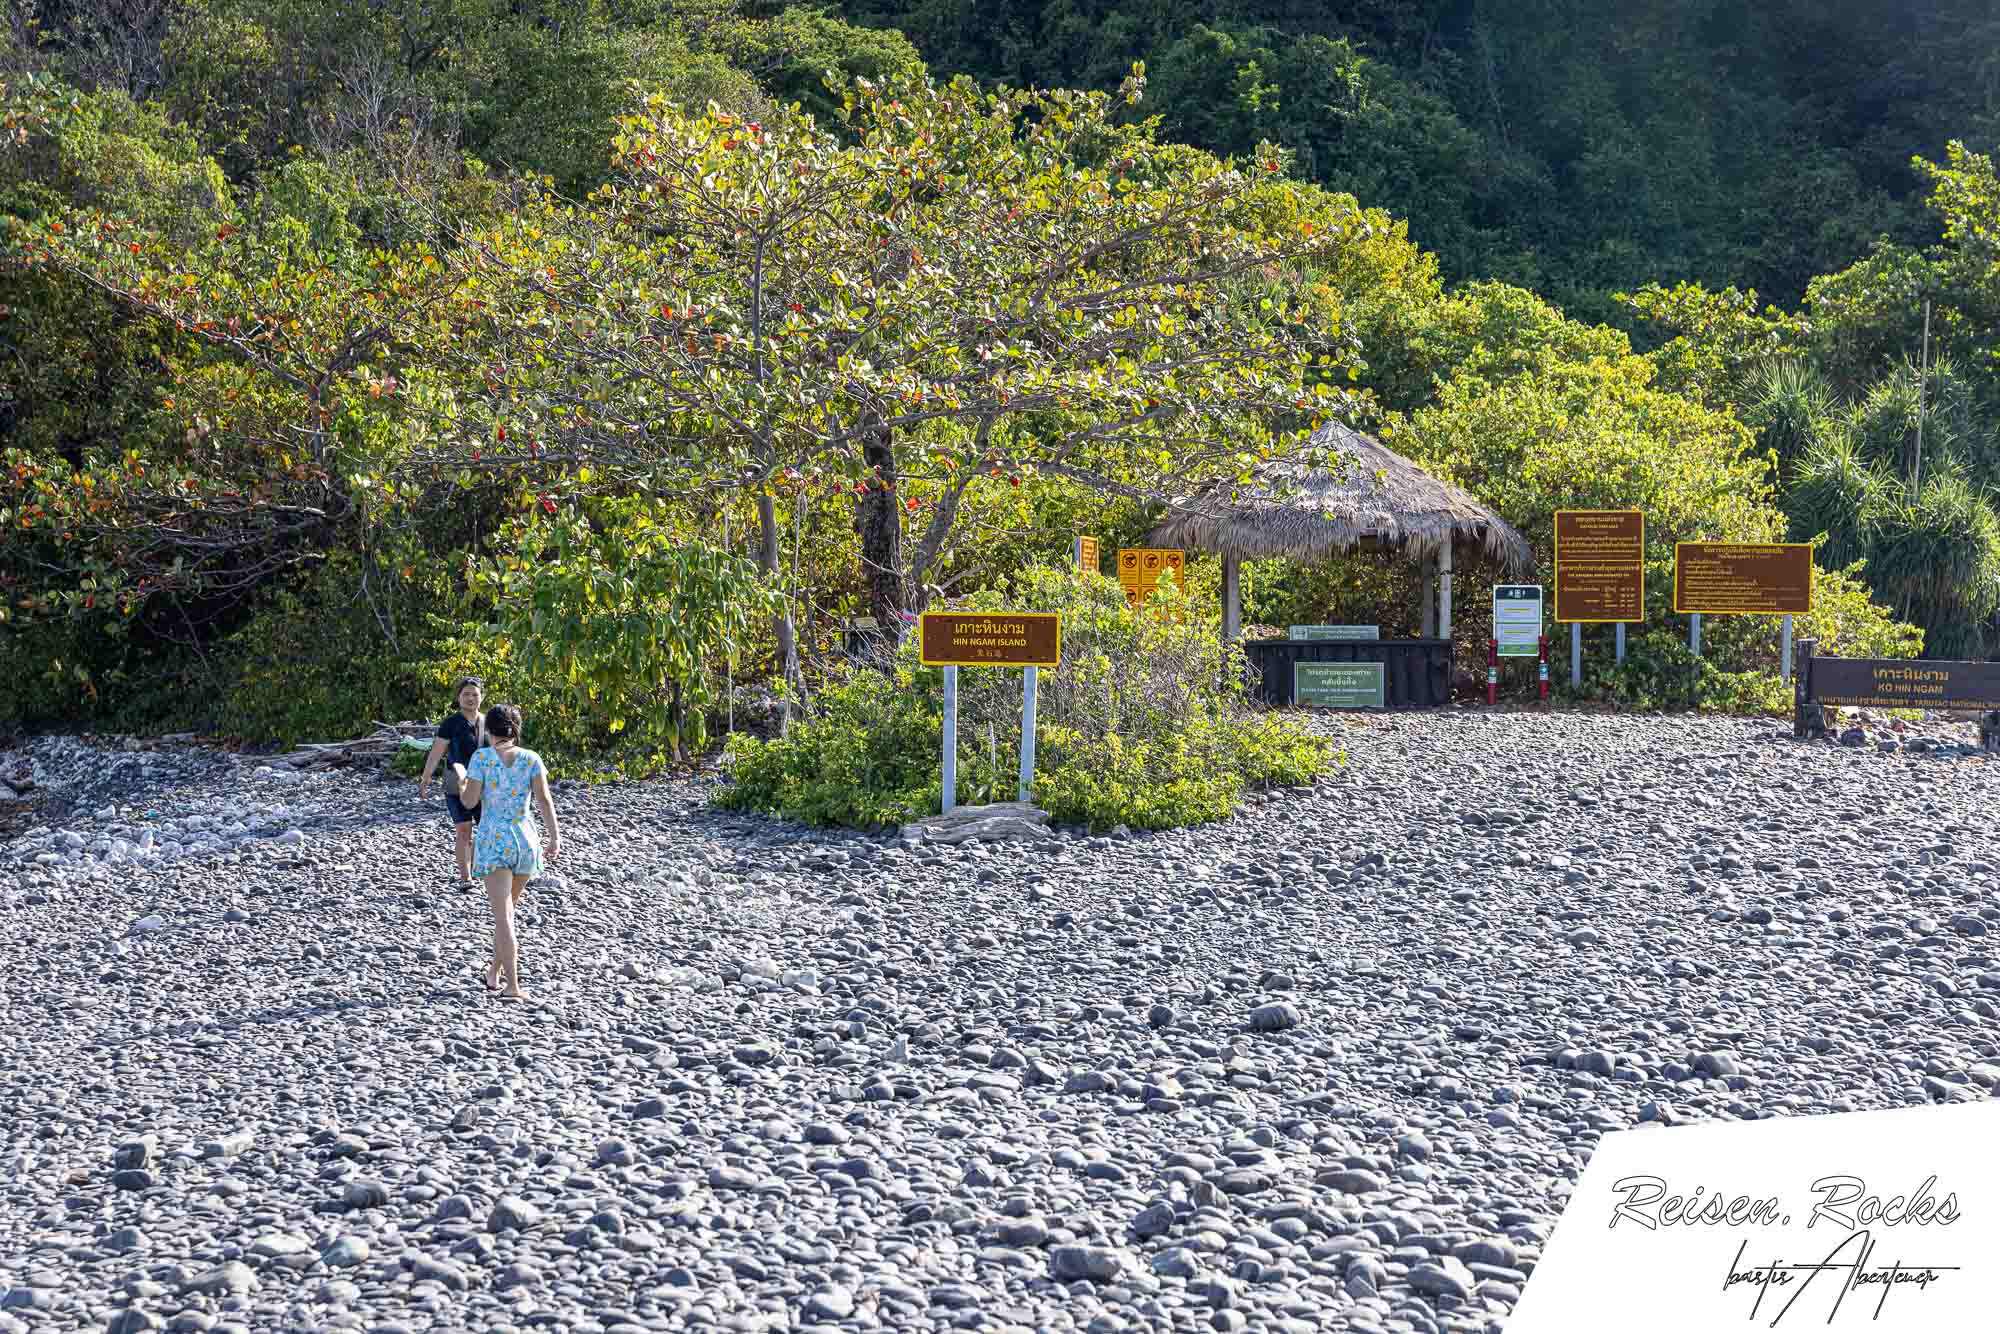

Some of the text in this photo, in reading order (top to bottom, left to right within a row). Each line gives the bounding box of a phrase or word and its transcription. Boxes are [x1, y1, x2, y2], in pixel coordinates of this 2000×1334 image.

[955, 619, 1025, 634] เกาะหินงาม
[953, 638, 1027, 646] HIN NGAM ISLAND
[1879, 682, 1943, 694] KO HIN NGAM
